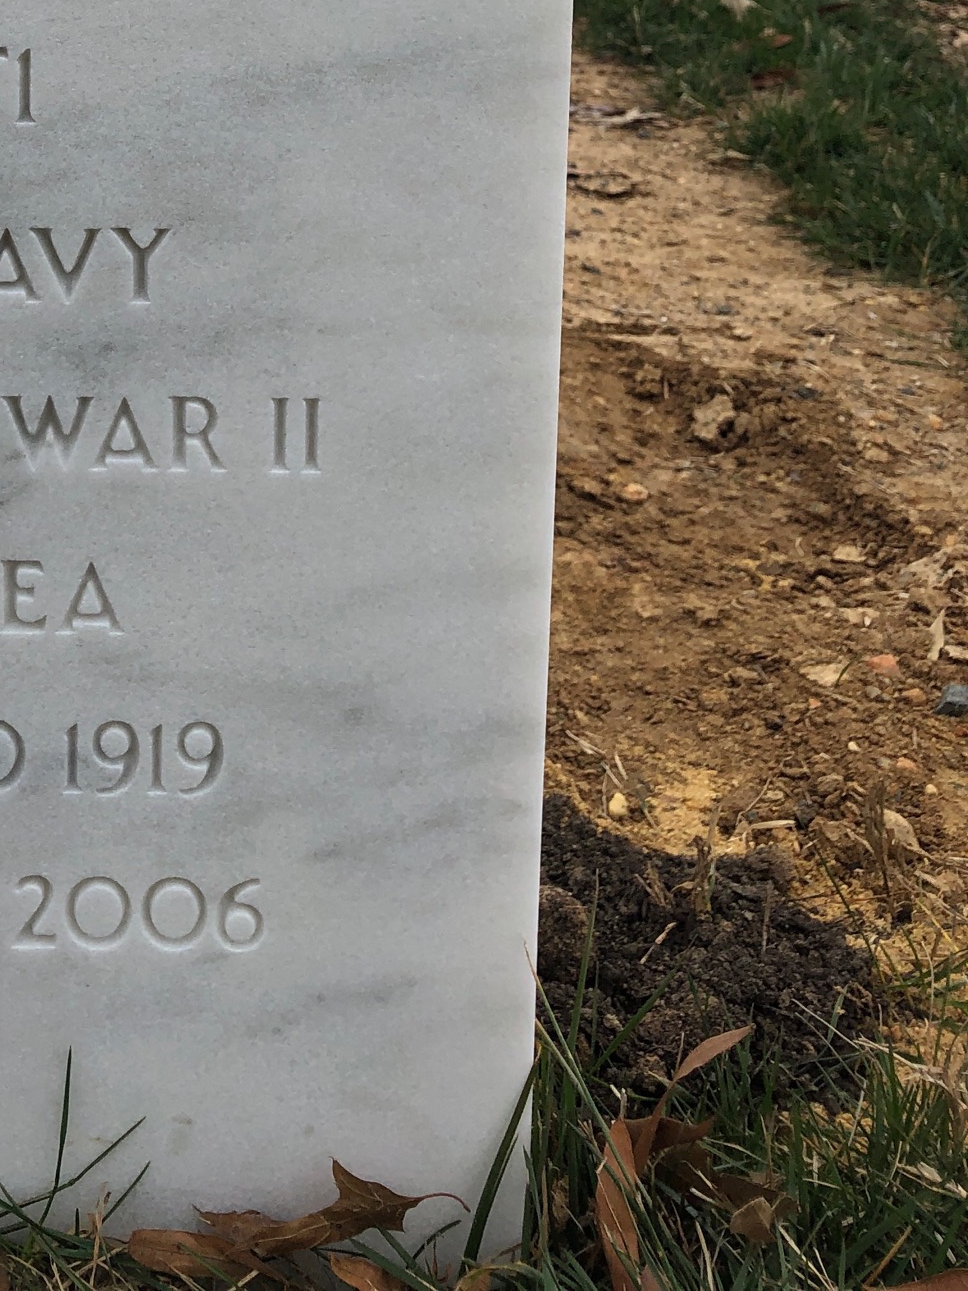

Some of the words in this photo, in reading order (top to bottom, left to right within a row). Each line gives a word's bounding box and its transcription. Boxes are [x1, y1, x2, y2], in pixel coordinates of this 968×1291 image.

[2, 395, 228, 473] WAR
[269, 396, 322, 474] II
[61, 720, 226, 796] 1919
[10, 875, 265, 952] 2006
